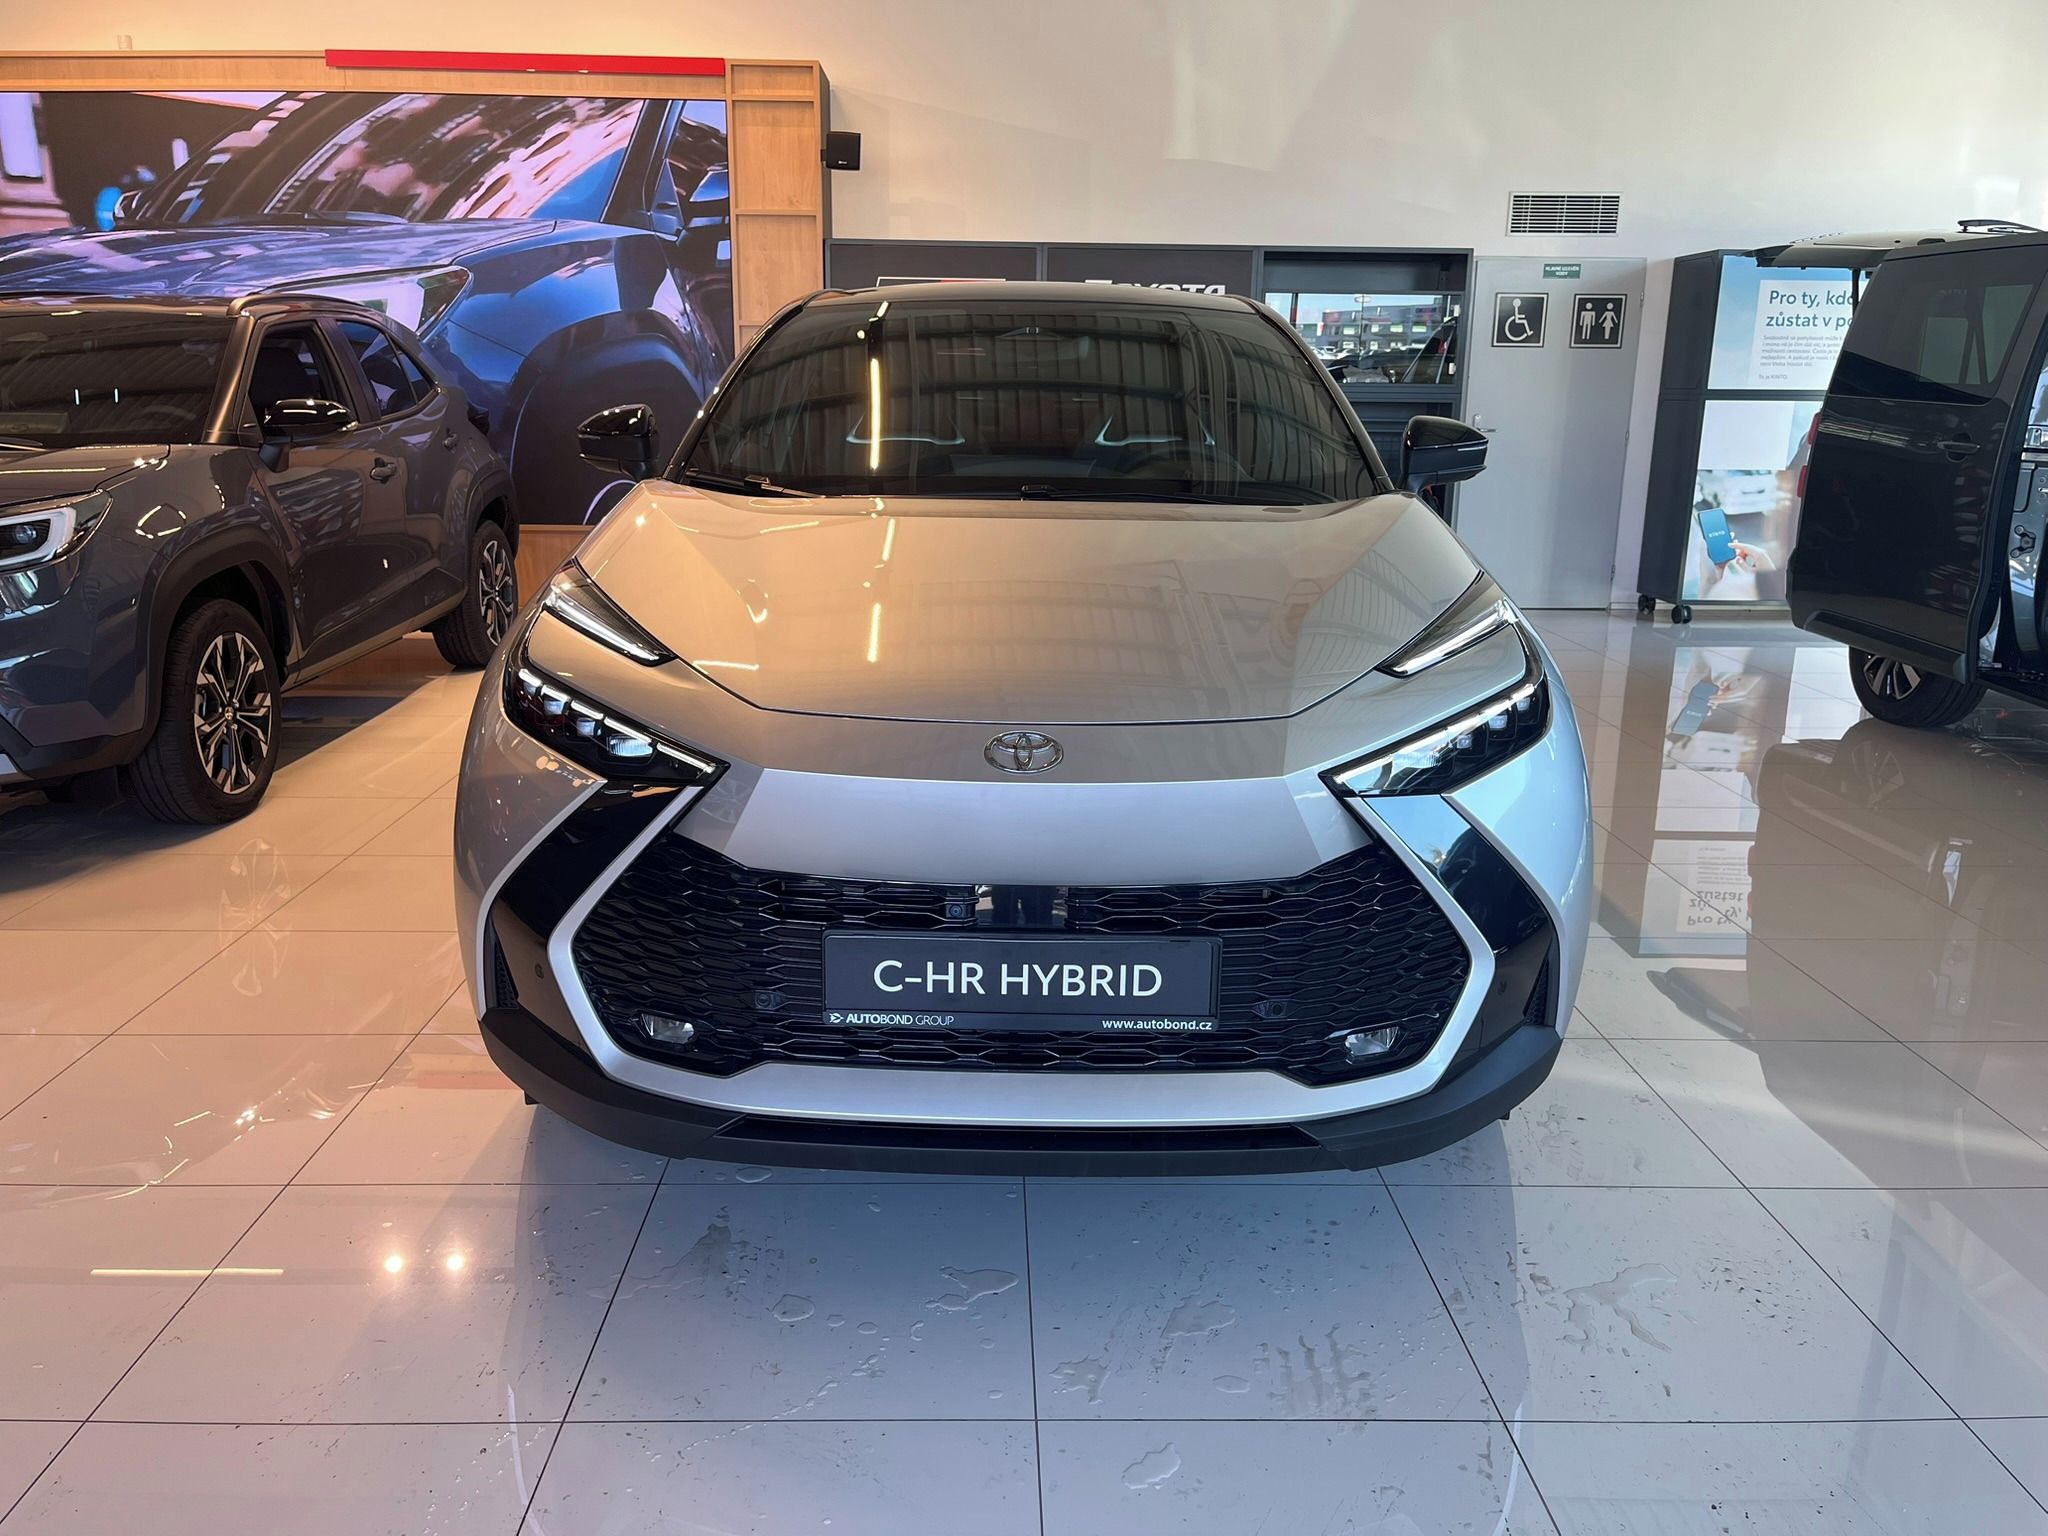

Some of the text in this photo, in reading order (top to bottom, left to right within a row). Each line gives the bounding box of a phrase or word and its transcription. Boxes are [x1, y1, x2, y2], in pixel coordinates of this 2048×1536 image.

[1769, 290, 1797, 305] Pro
[1801, 291, 1821, 309] ty,
[1766, 311, 1818, 327] zůstat
[1822, 316, 1832, 327] v
[873, 959, 1162, 997] C-HR HYBRID
[846, 1013, 955, 1026] AUTOBOND GROUP
[1102, 1018, 1213, 1030] www.autobond.cz
